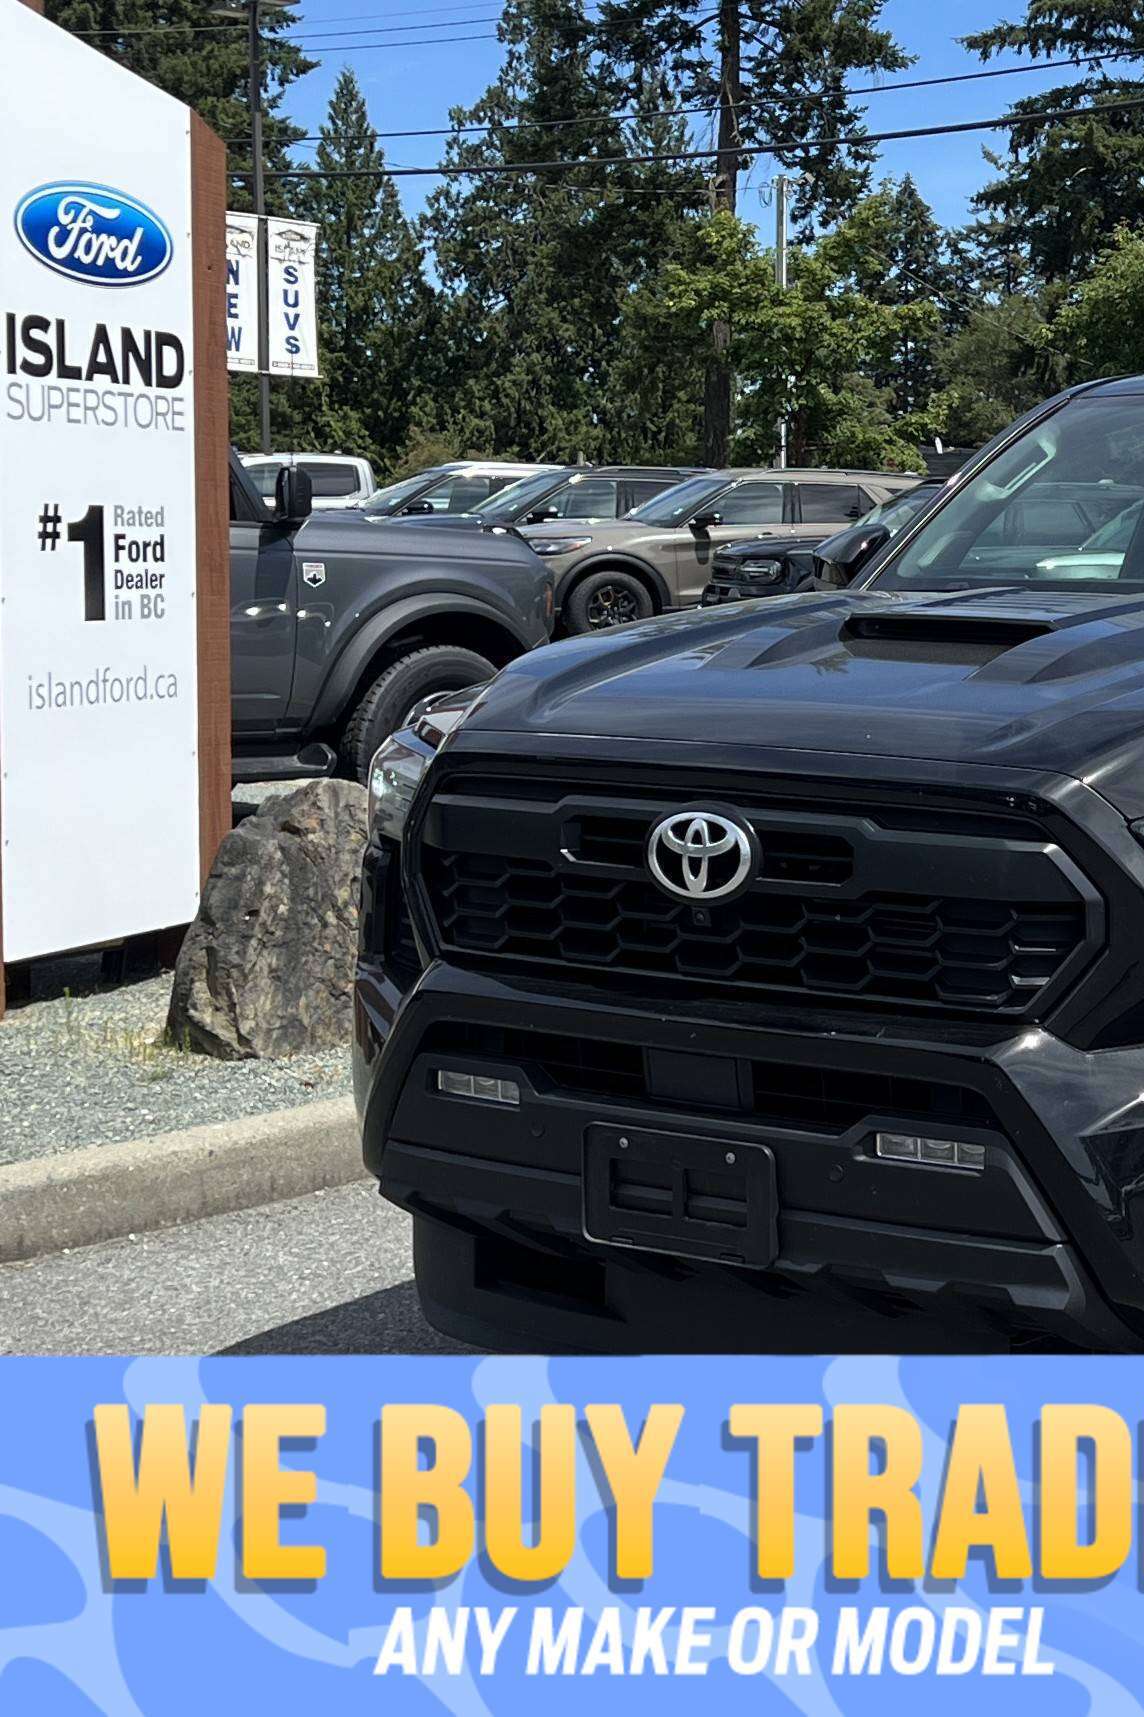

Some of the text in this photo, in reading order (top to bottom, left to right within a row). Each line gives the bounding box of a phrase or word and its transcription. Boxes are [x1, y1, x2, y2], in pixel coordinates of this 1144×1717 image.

[47, 195, 144, 273] Ford
[282, 265, 301, 355] SUVS
[6, 312, 185, 389] ISLAND
[6, 382, 185, 431] SUPERSTORE
[113, 505, 165, 528] Rated
[113, 533, 166, 563] Ford
[114, 569, 165, 590] Dealer
[114, 594, 165, 620] in BC
[28, 664, 179, 711] islandford.ca
